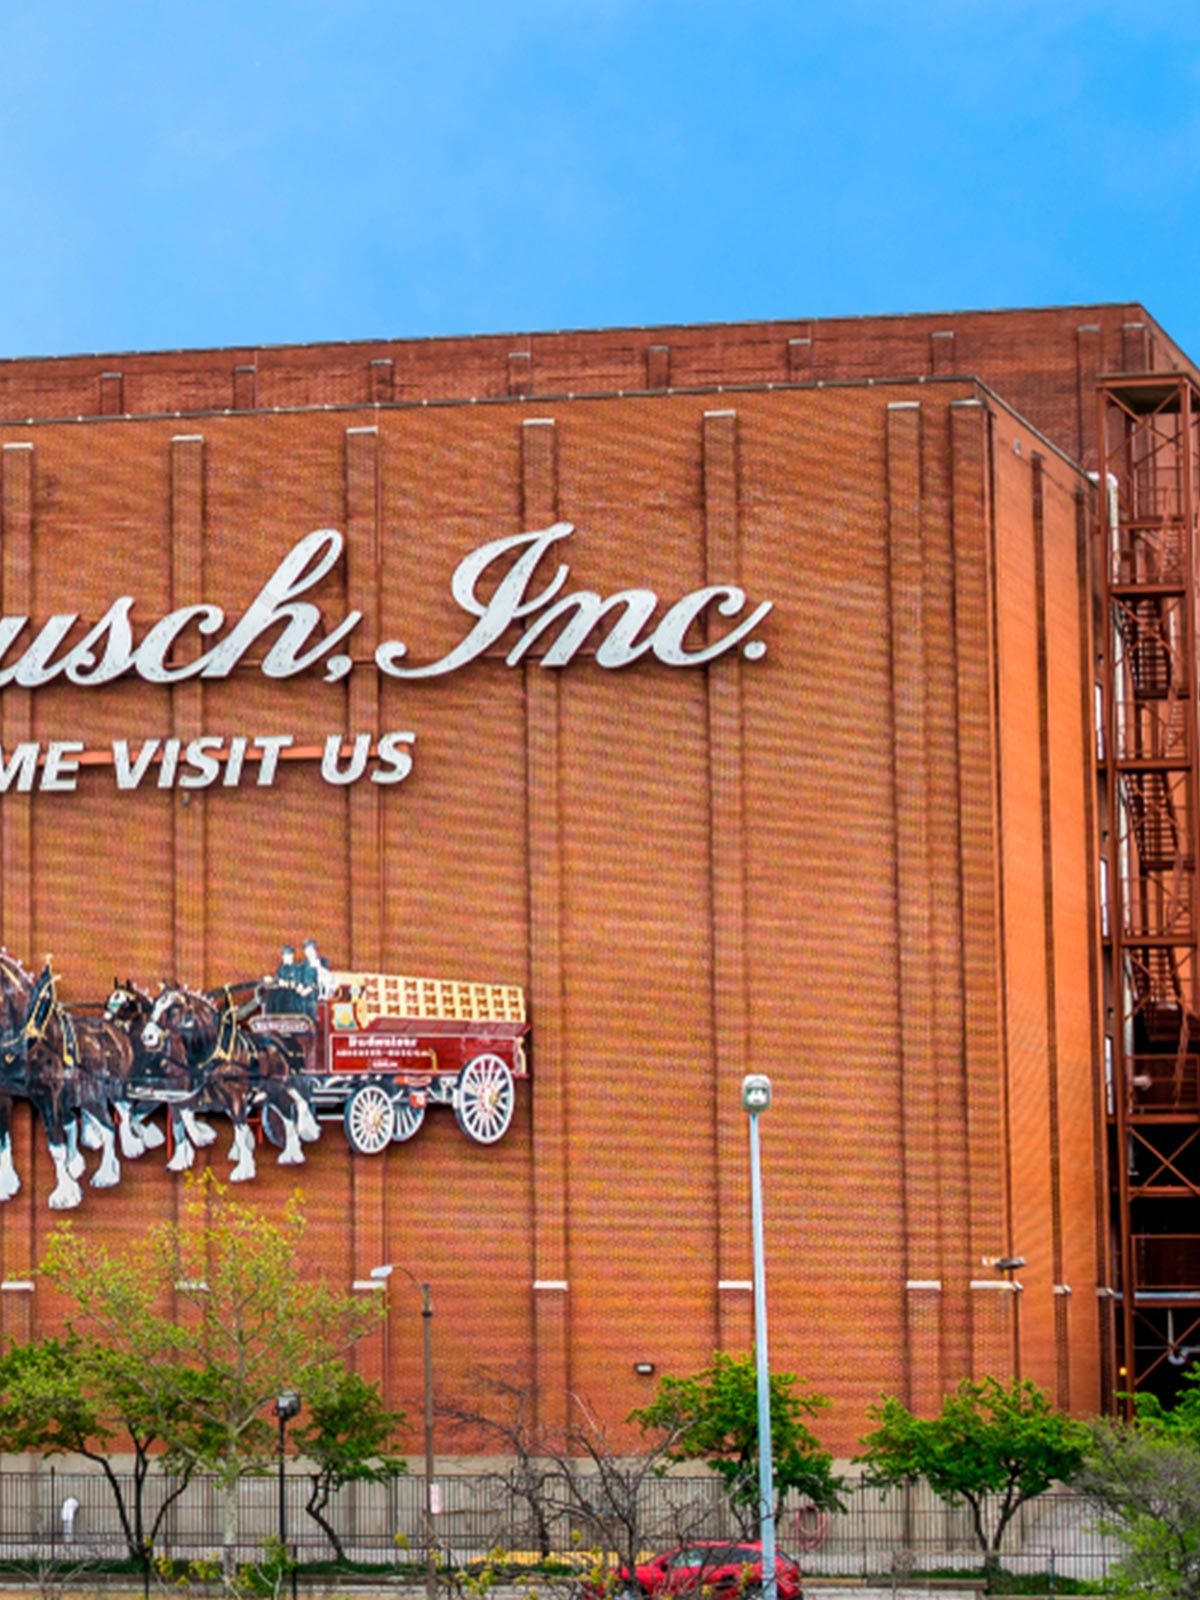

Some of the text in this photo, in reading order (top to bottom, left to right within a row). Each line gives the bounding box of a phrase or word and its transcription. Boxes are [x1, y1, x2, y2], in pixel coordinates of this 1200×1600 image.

[374, 522, 773, 680] Inc.
[112, 734, 294, 790] VISIT
[320, 730, 417, 786] US
